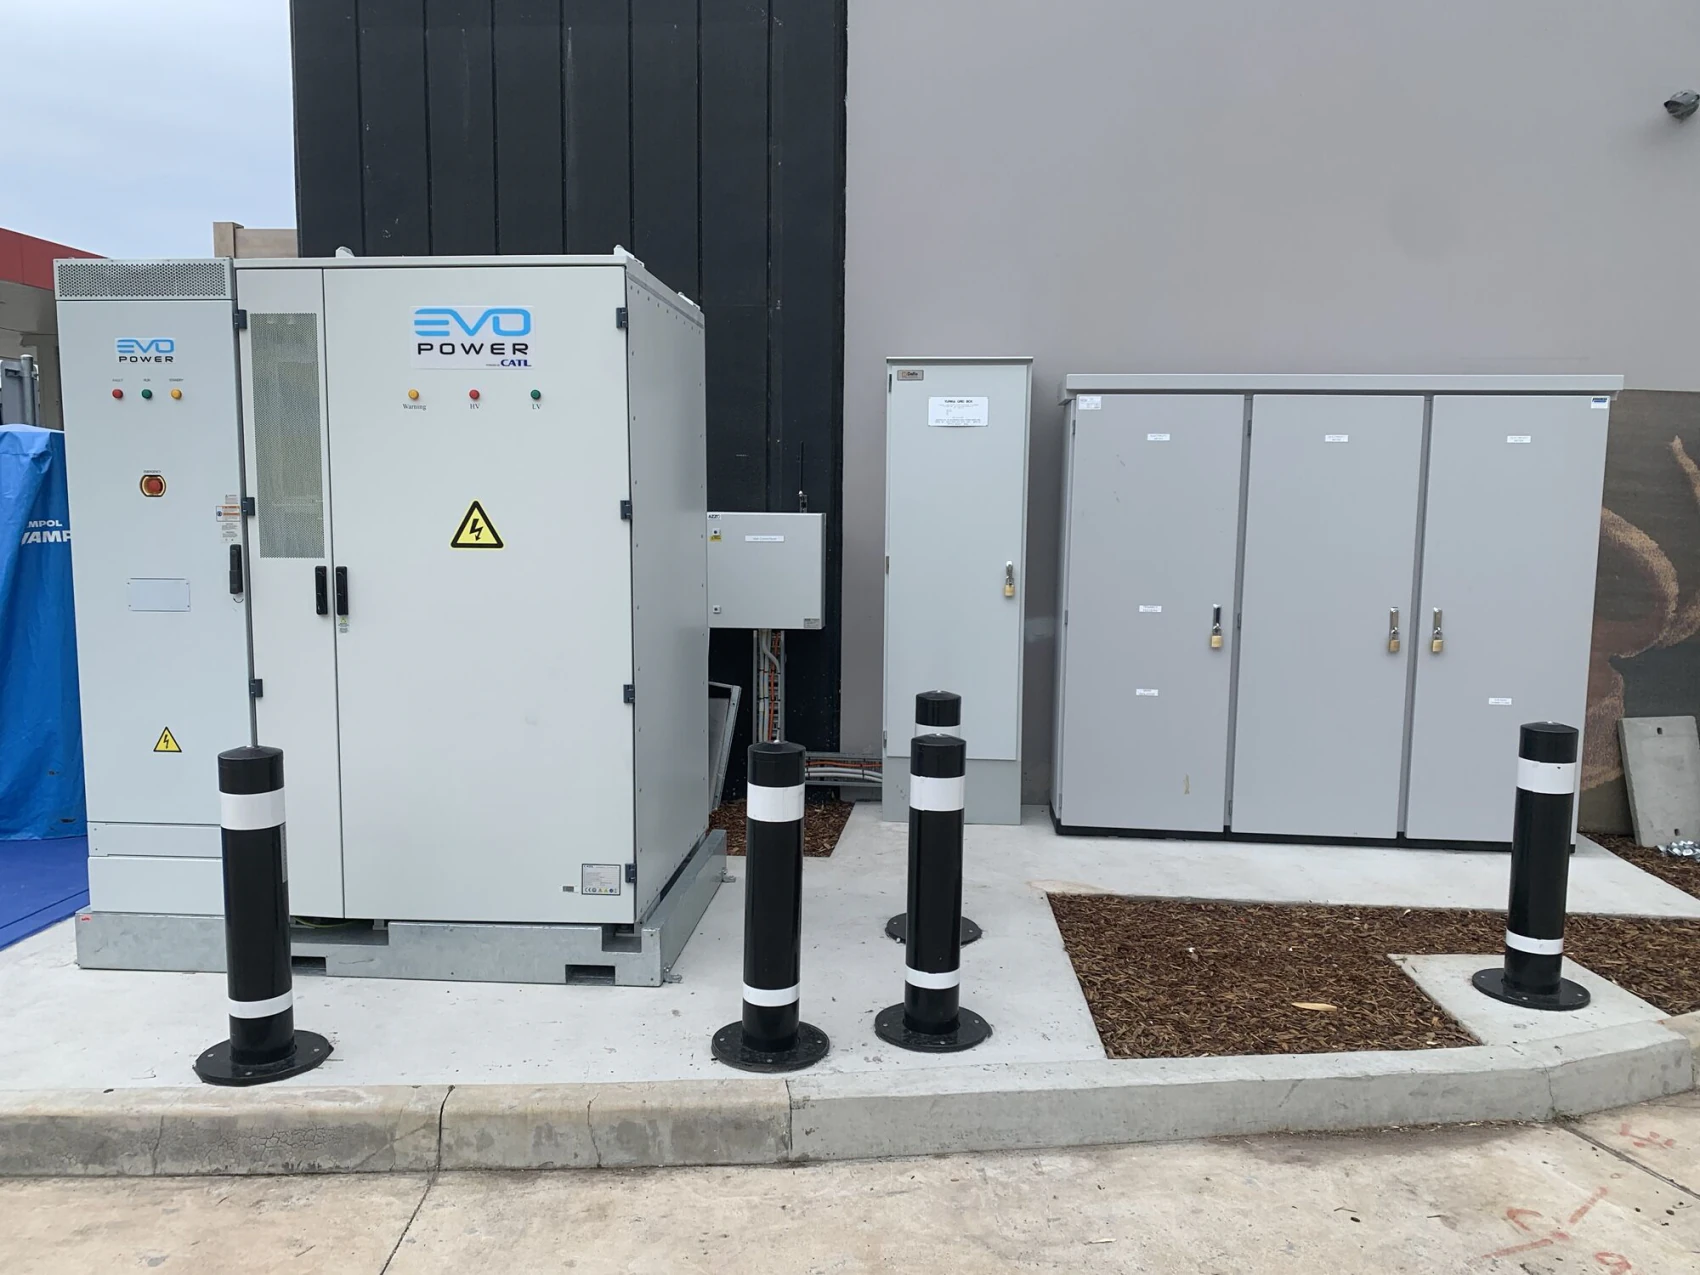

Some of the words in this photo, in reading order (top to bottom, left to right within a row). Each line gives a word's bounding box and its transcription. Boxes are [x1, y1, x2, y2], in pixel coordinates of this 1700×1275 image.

[414, 308, 531, 336] EVO
[117, 339, 175, 353] EVO
[417, 343, 529, 355] POWER
[118, 355, 174, 363] POWER
[501, 359, 532, 367] CATL
[402, 403, 427, 411] Warning
[28, 520, 63, 528] MPOL
